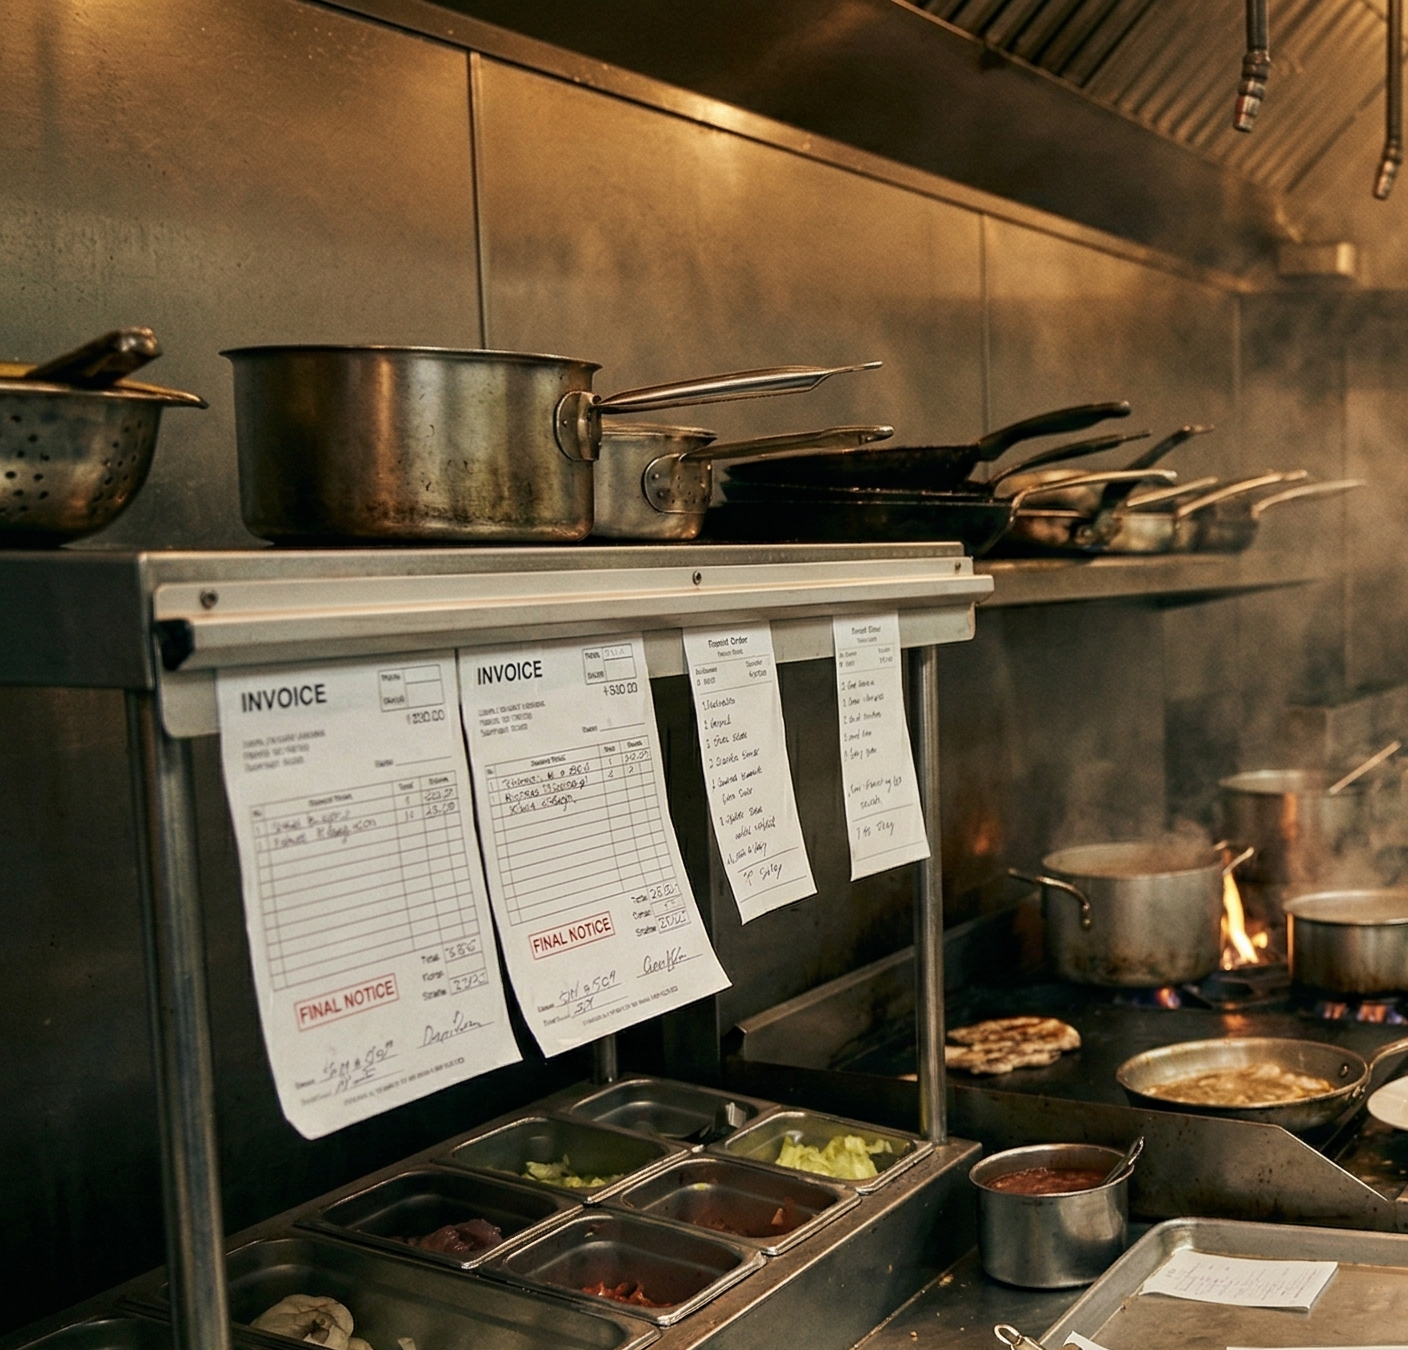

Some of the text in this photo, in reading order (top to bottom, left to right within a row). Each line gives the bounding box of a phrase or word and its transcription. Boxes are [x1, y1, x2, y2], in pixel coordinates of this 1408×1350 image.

[477, 660, 543, 685] INVOICE
[241, 683, 327, 713] INVOICE
[533, 917, 611, 954] FINAL NOTICE
[300, 979, 395, 1025] FINAL NOTICE
